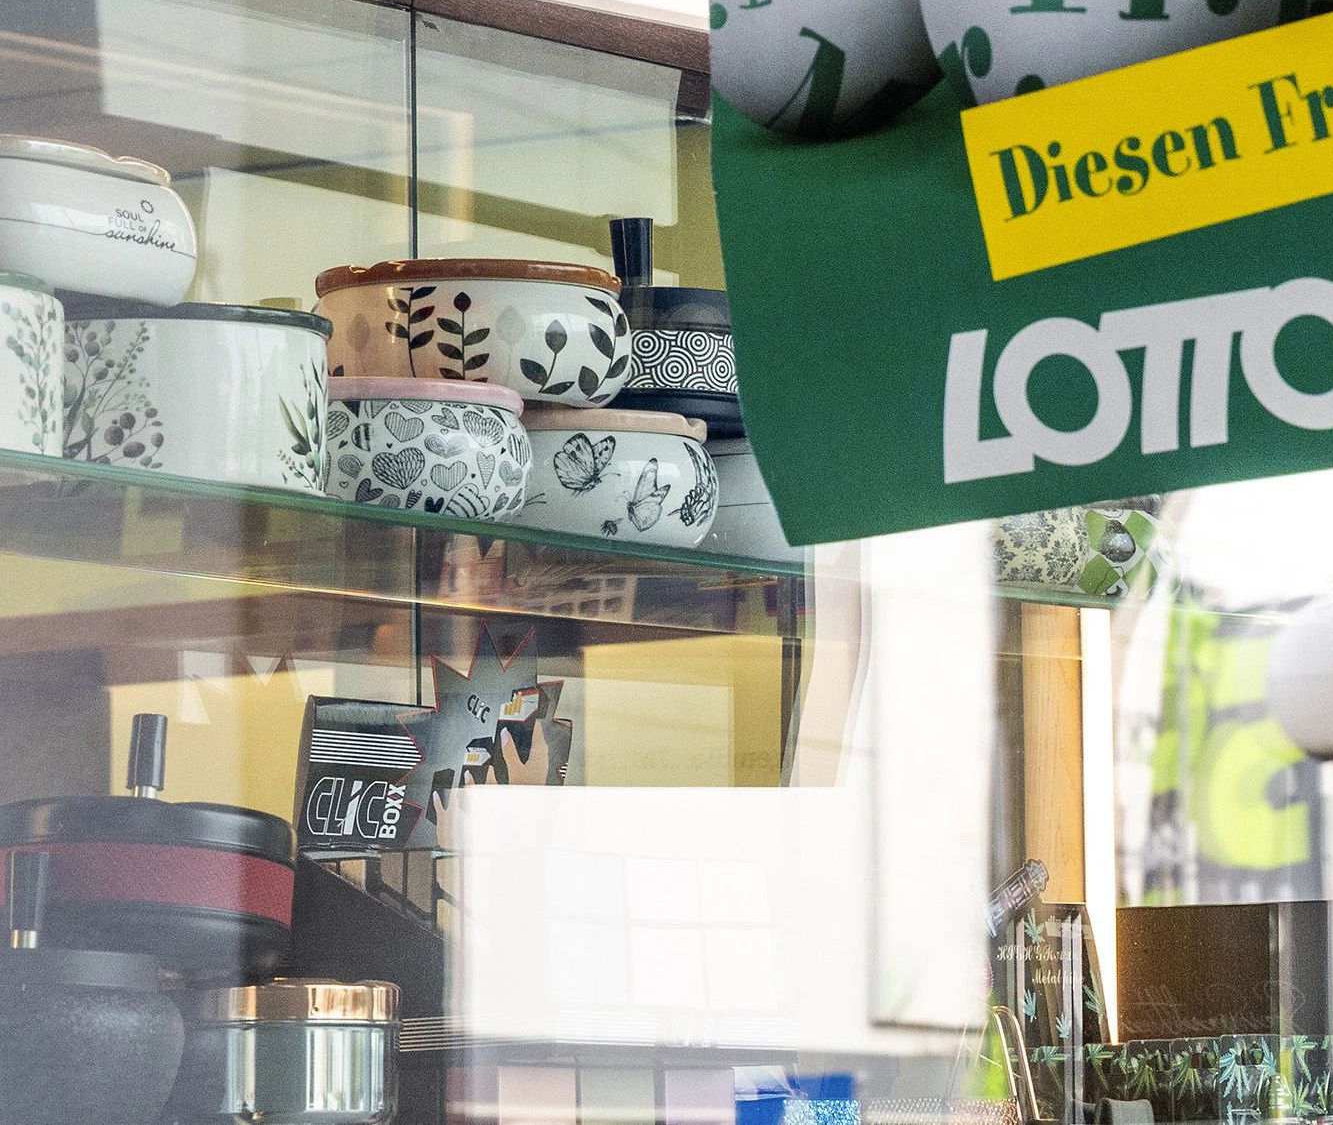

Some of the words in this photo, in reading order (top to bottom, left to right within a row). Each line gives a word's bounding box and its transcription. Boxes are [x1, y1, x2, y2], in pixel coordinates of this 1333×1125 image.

[990, 118, 1241, 221] Diesen
[107, 216, 136, 230] FULL
[115, 208, 144, 223] SOUL
[104, 218, 176, 251] sunshine
[378, 783, 407, 839] BOXX
